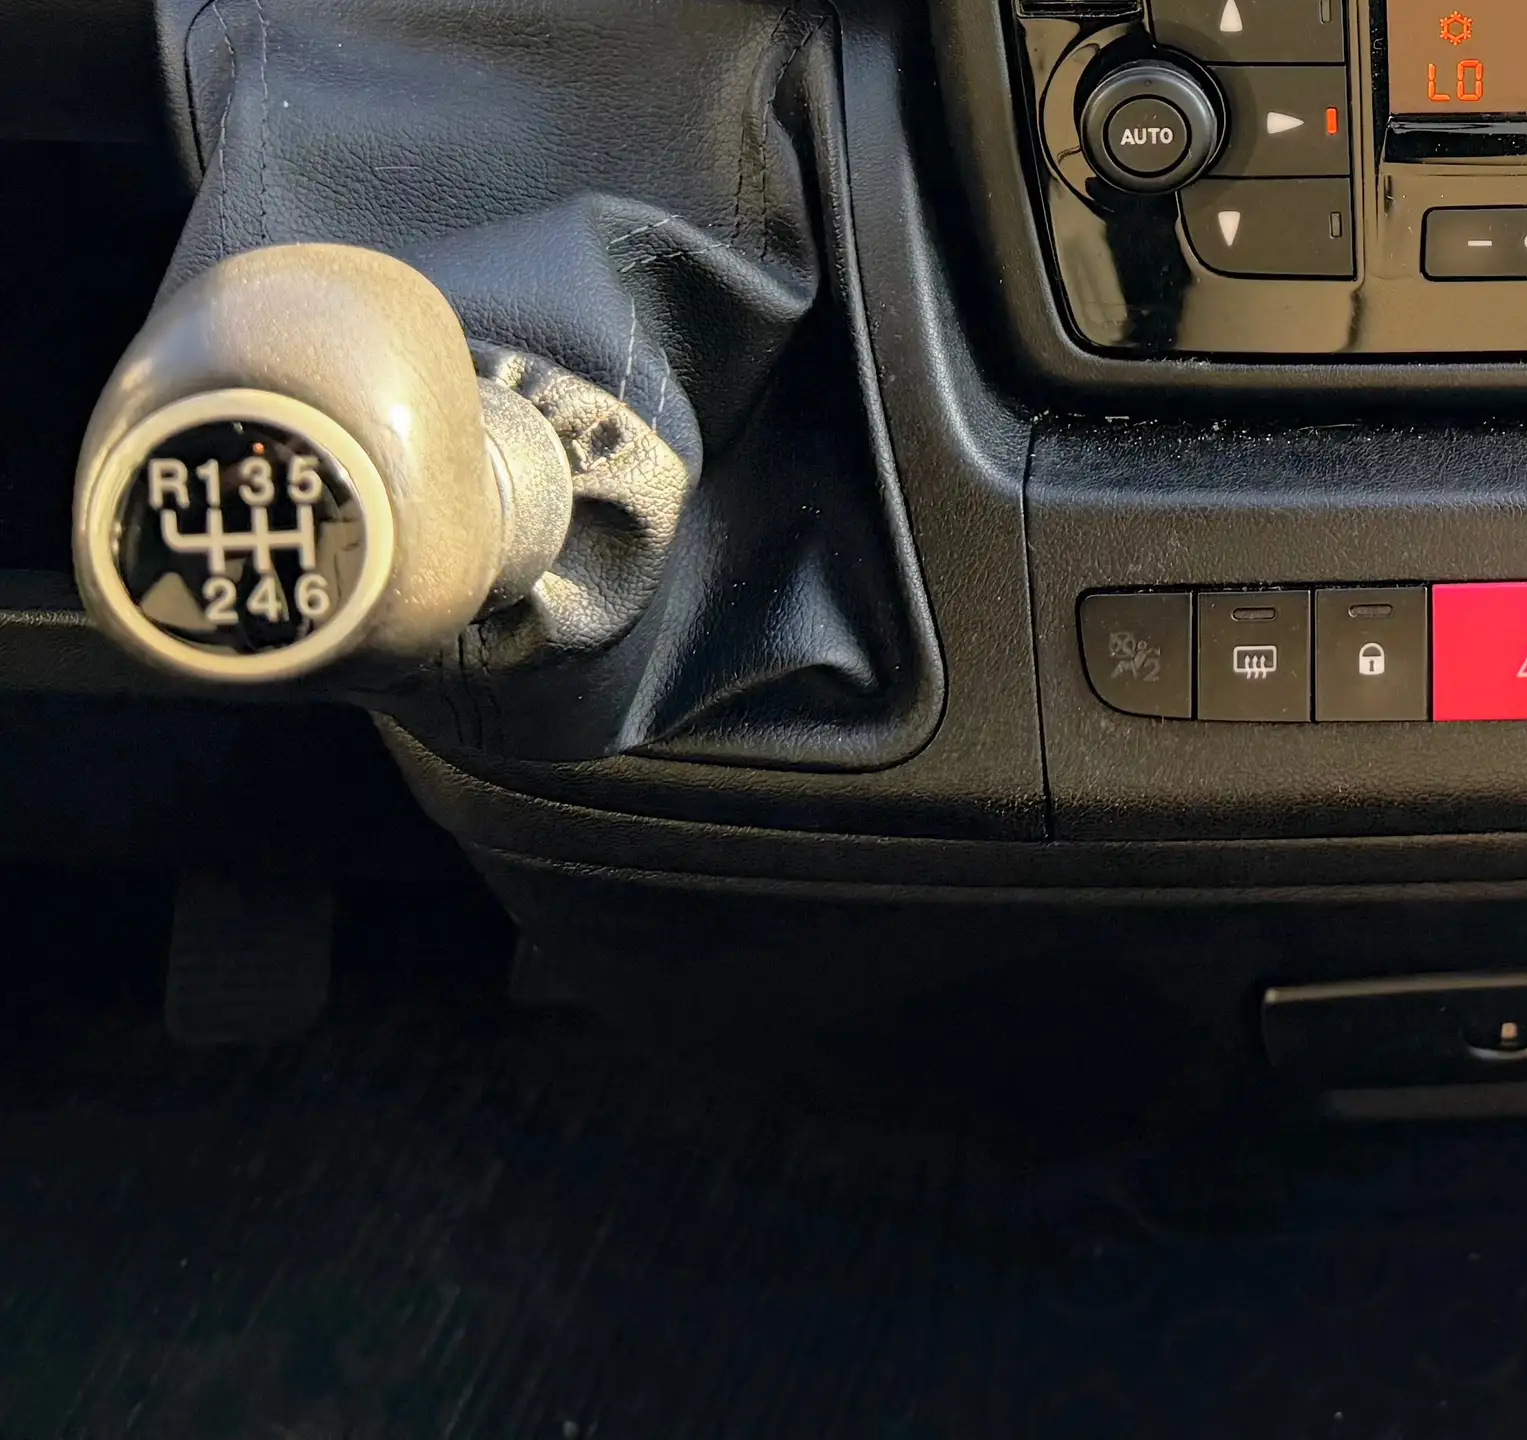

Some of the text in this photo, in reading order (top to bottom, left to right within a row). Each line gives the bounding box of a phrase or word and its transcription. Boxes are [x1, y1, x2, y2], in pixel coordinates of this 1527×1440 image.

[1427, 59, 1484, 101] LO
[1120, 127, 1173, 145] AUTO
[149, 456, 322, 509] R 1 3 5
[203, 572, 330, 624] 2 4 6
